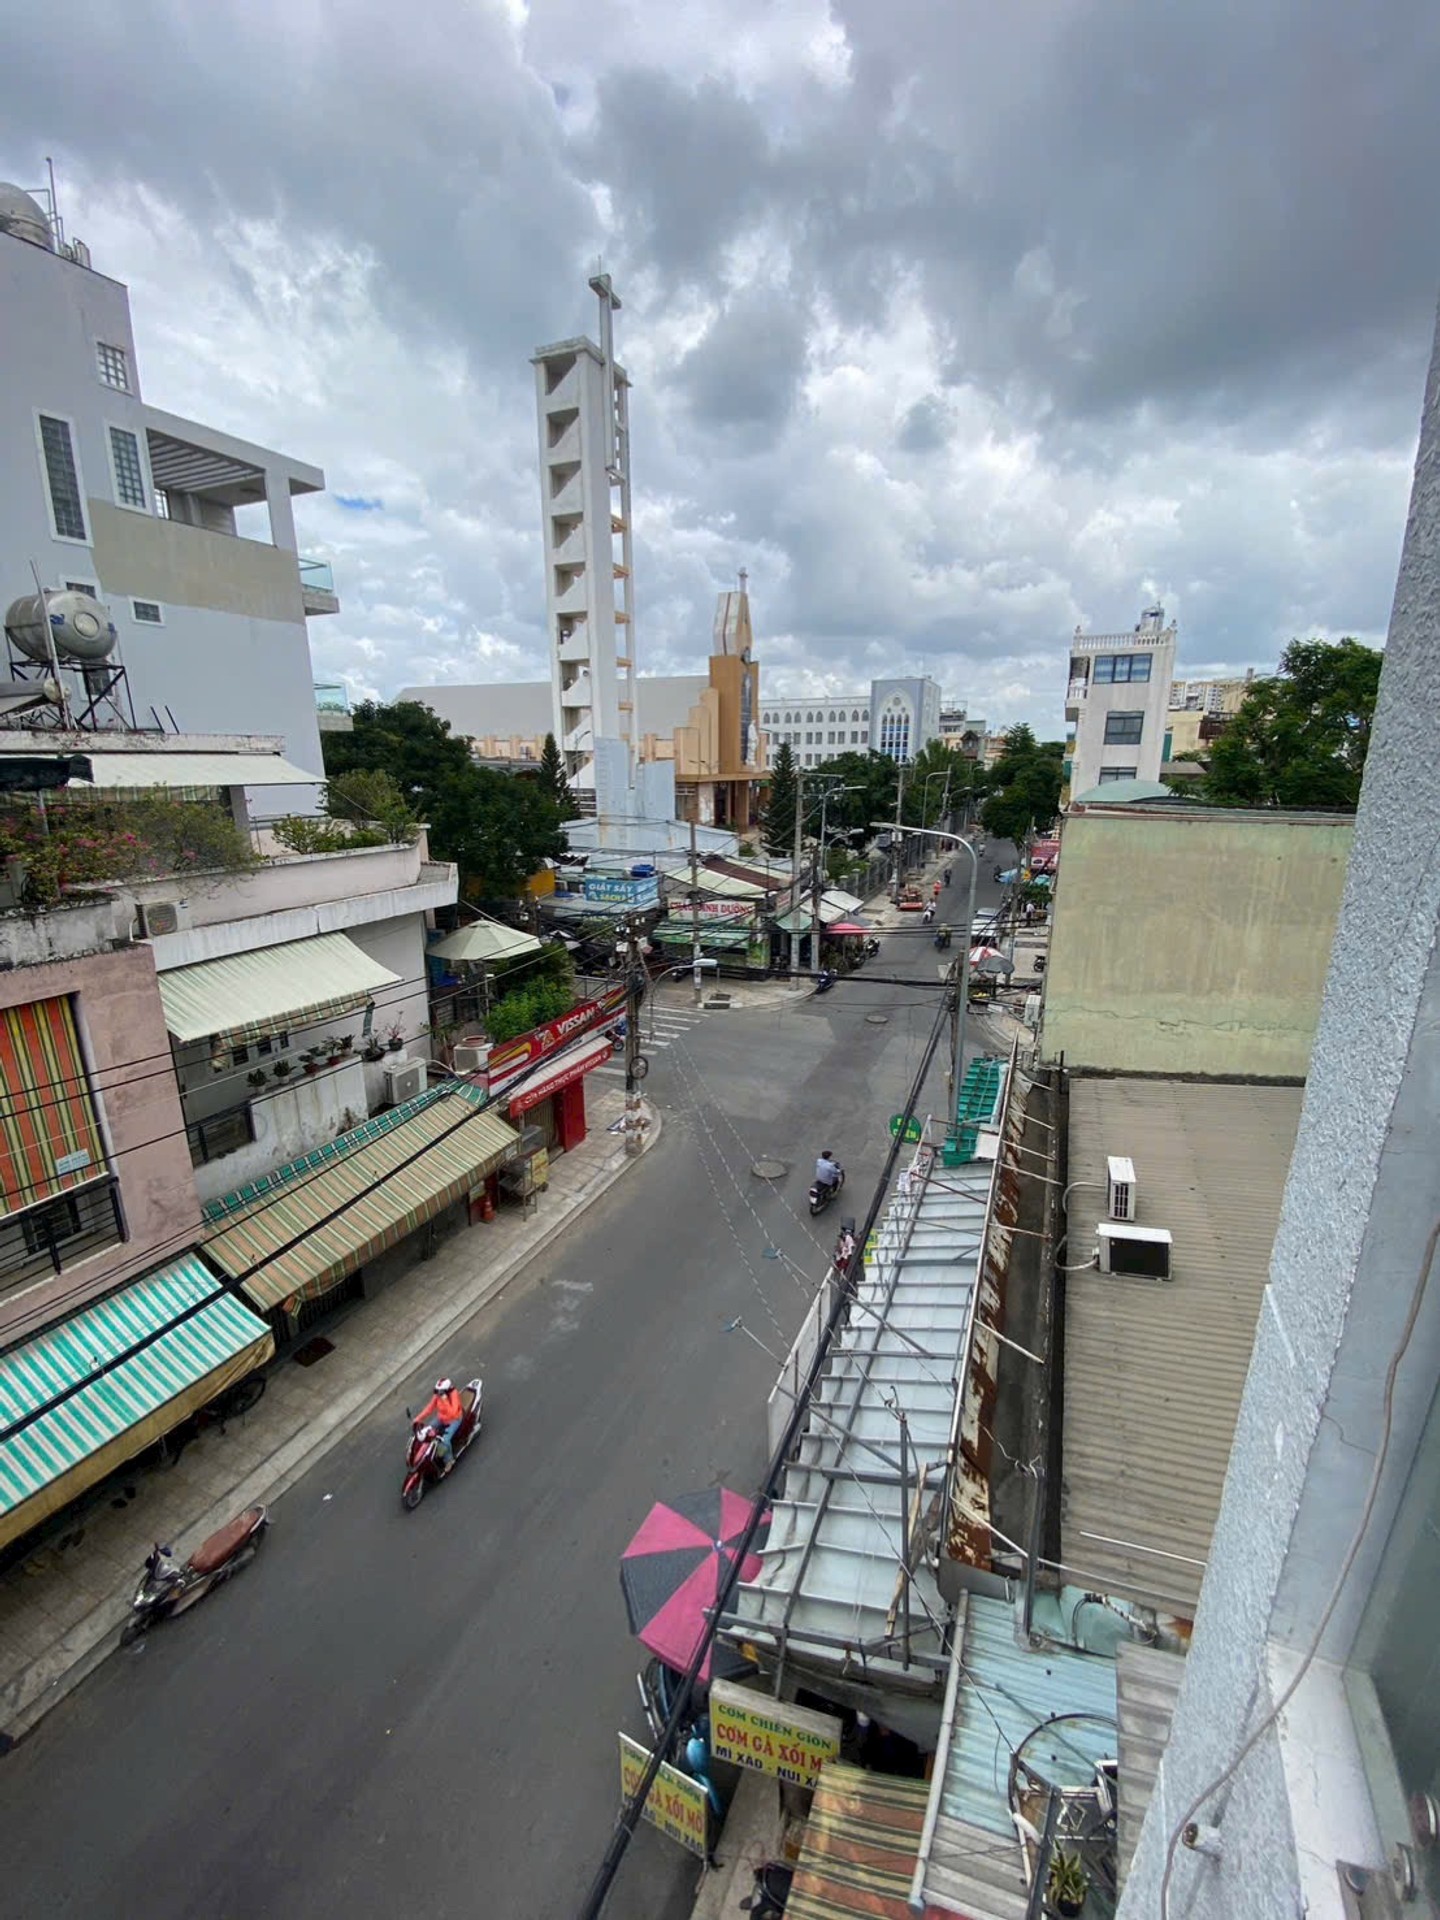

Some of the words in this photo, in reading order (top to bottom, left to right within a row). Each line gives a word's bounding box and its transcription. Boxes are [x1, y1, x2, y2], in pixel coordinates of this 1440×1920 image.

[556, 1006, 595, 1034] VISSAN
[752, 1734, 774, 1756] GÀ
[778, 1742, 806, 1767] XỐI
